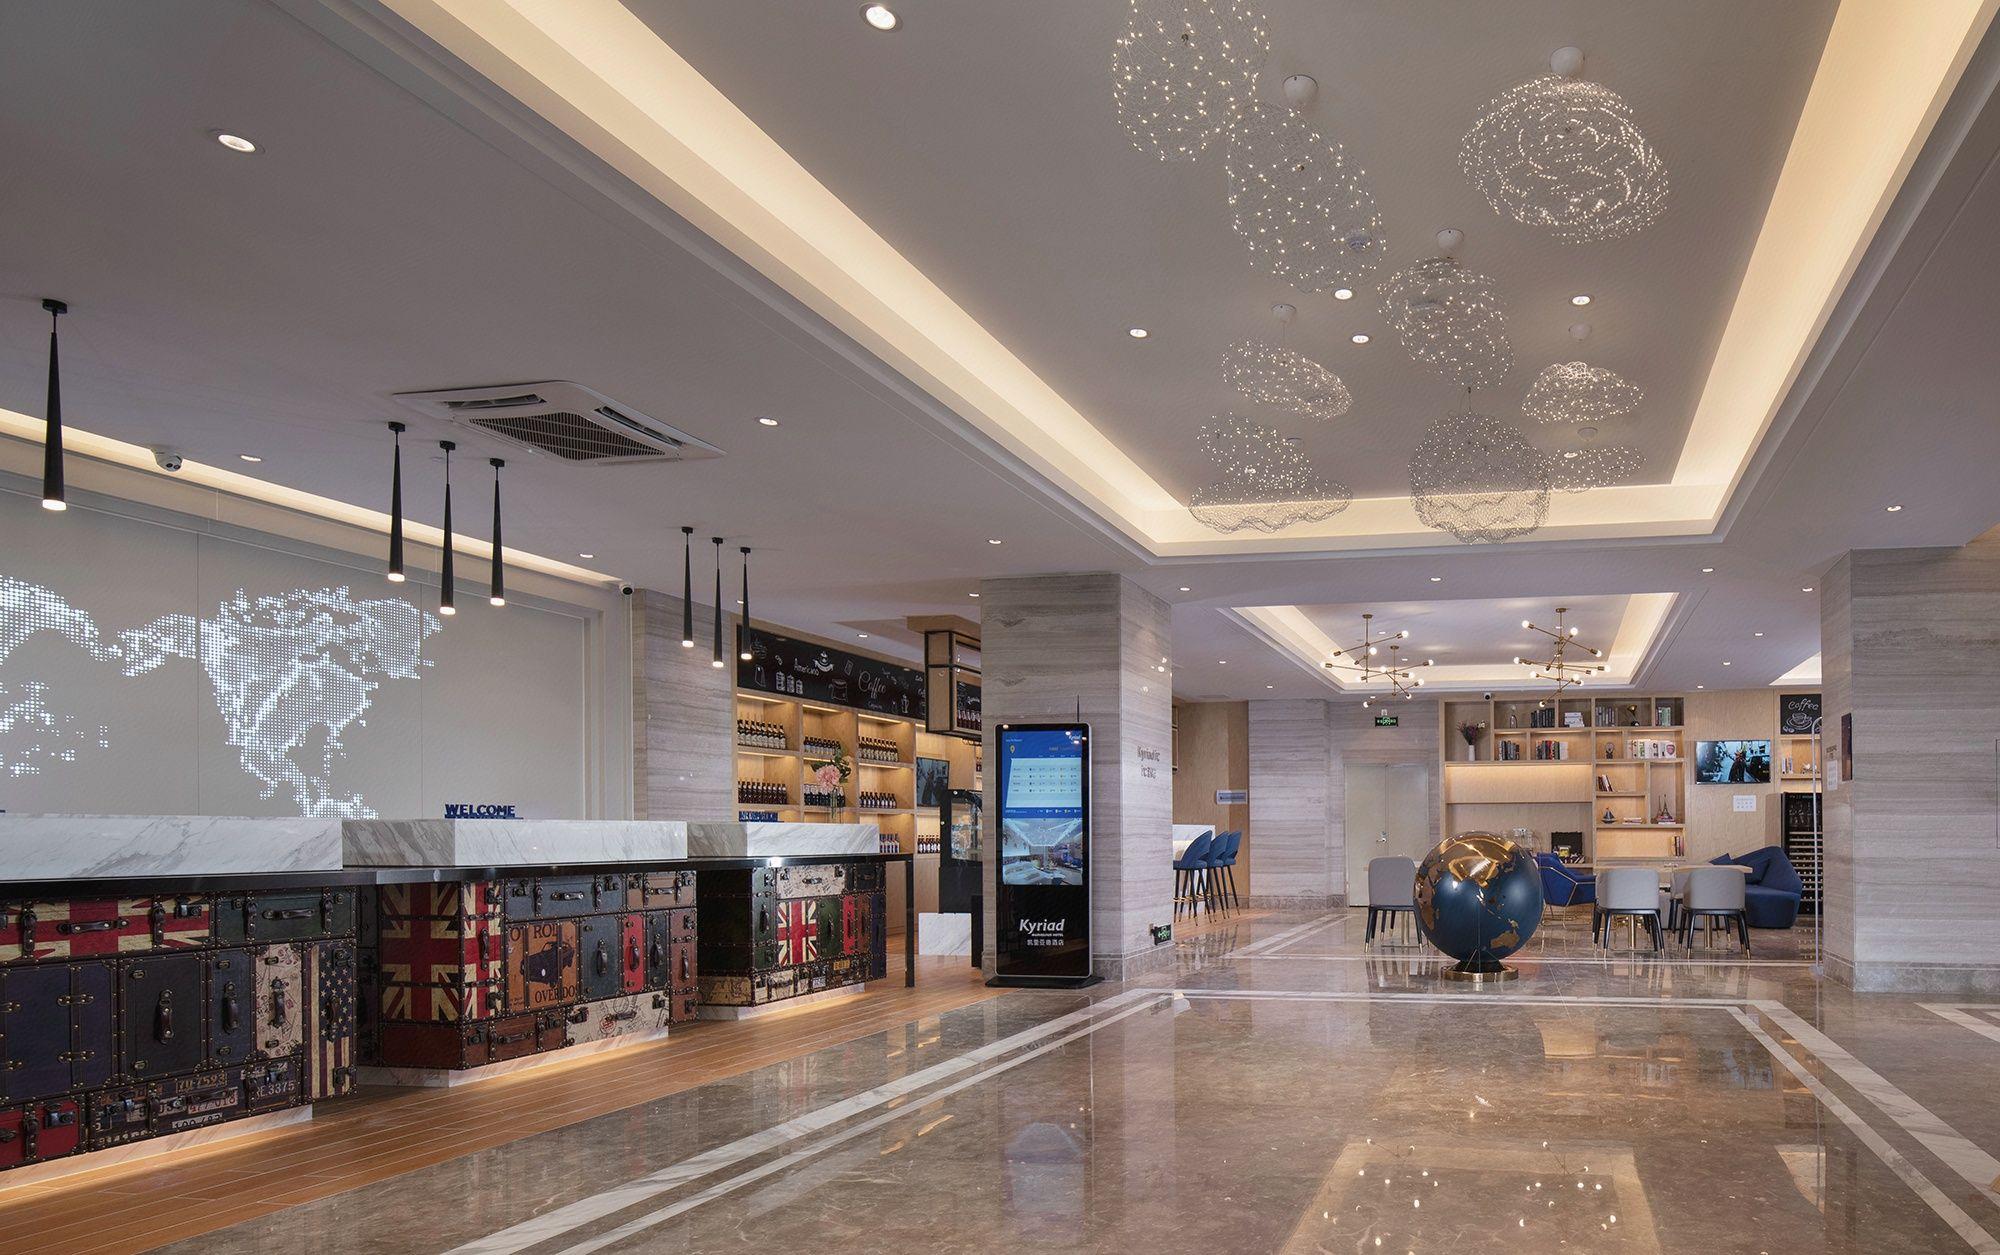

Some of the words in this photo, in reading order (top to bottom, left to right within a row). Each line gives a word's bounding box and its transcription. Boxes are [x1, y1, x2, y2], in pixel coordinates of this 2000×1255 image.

[858, 670, 887, 699] Coffee
[445, 803, 516, 818] WELCOME
[1019, 918, 1065, 935] Kyriad
